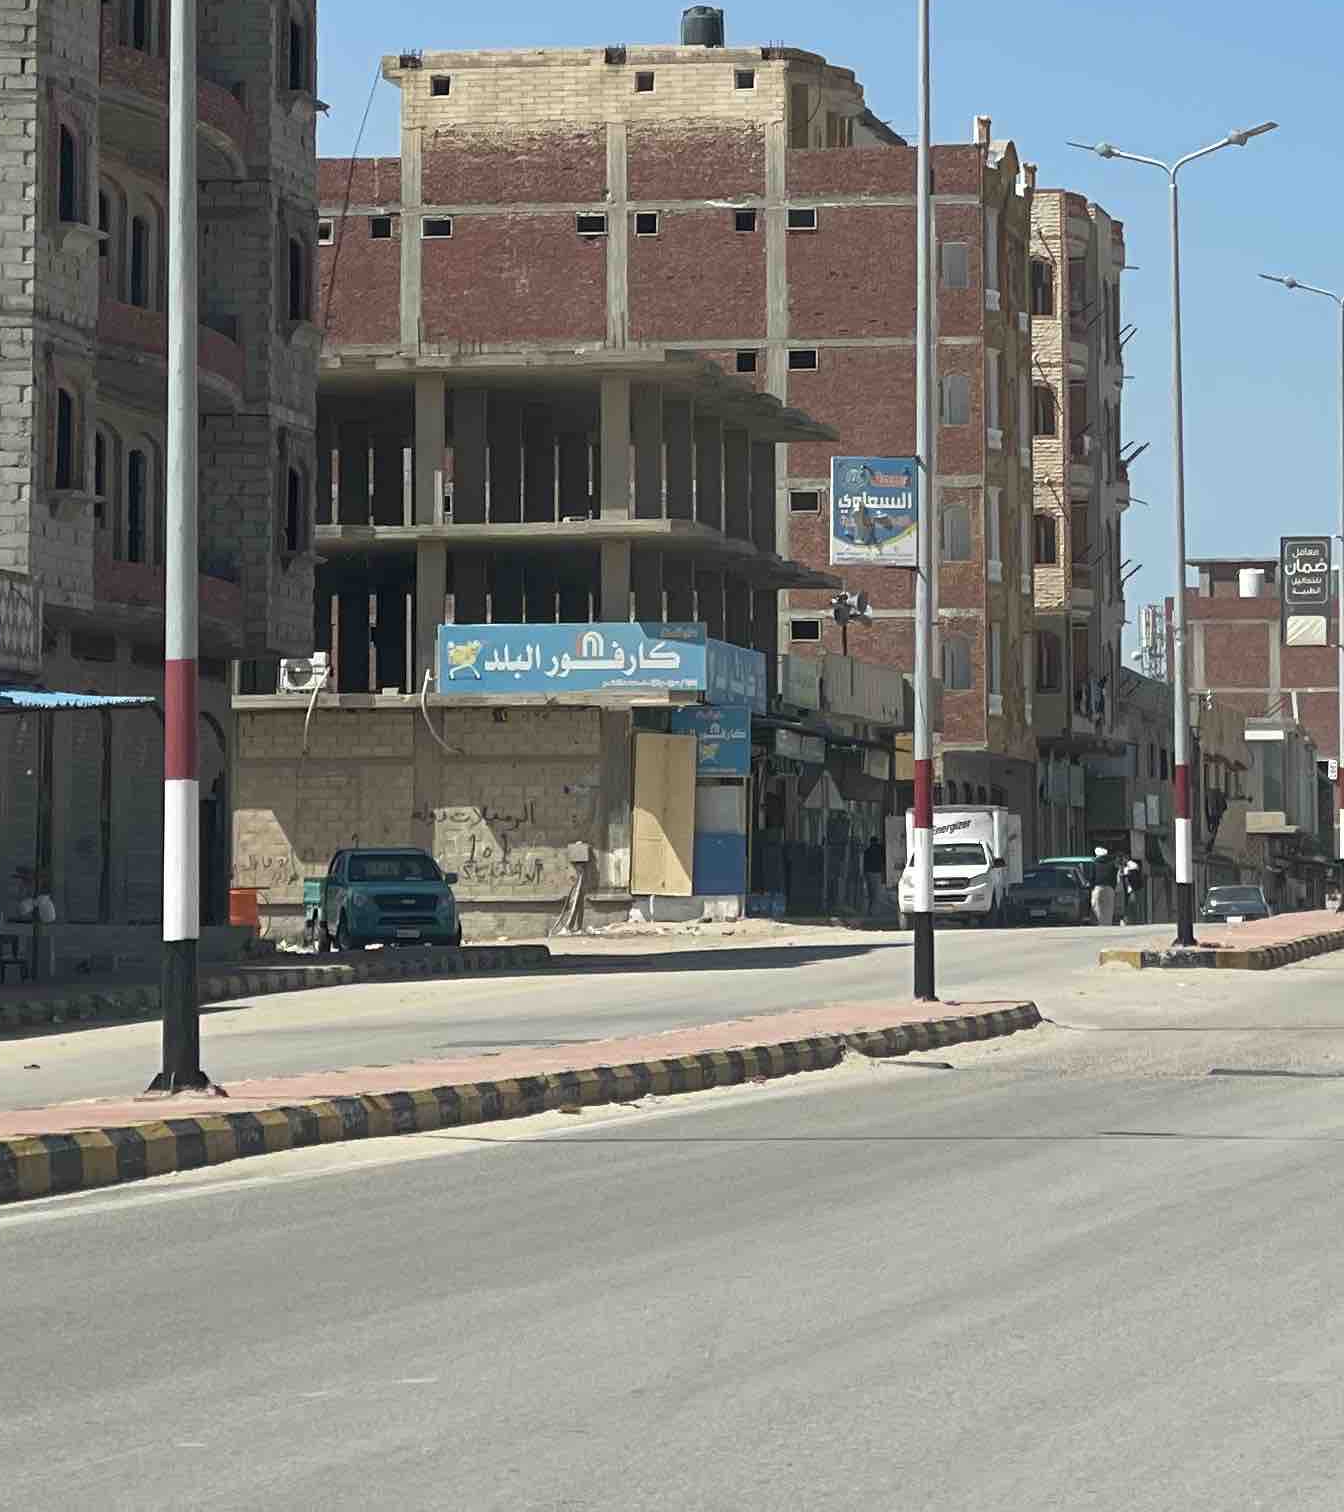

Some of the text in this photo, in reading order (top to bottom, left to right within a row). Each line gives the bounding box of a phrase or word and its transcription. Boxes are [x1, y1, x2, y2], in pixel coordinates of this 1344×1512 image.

[1284, 558, 1328, 575] ضمان
[484, 642, 542, 679] البلد
[545, 642, 680, 677] كارفور
